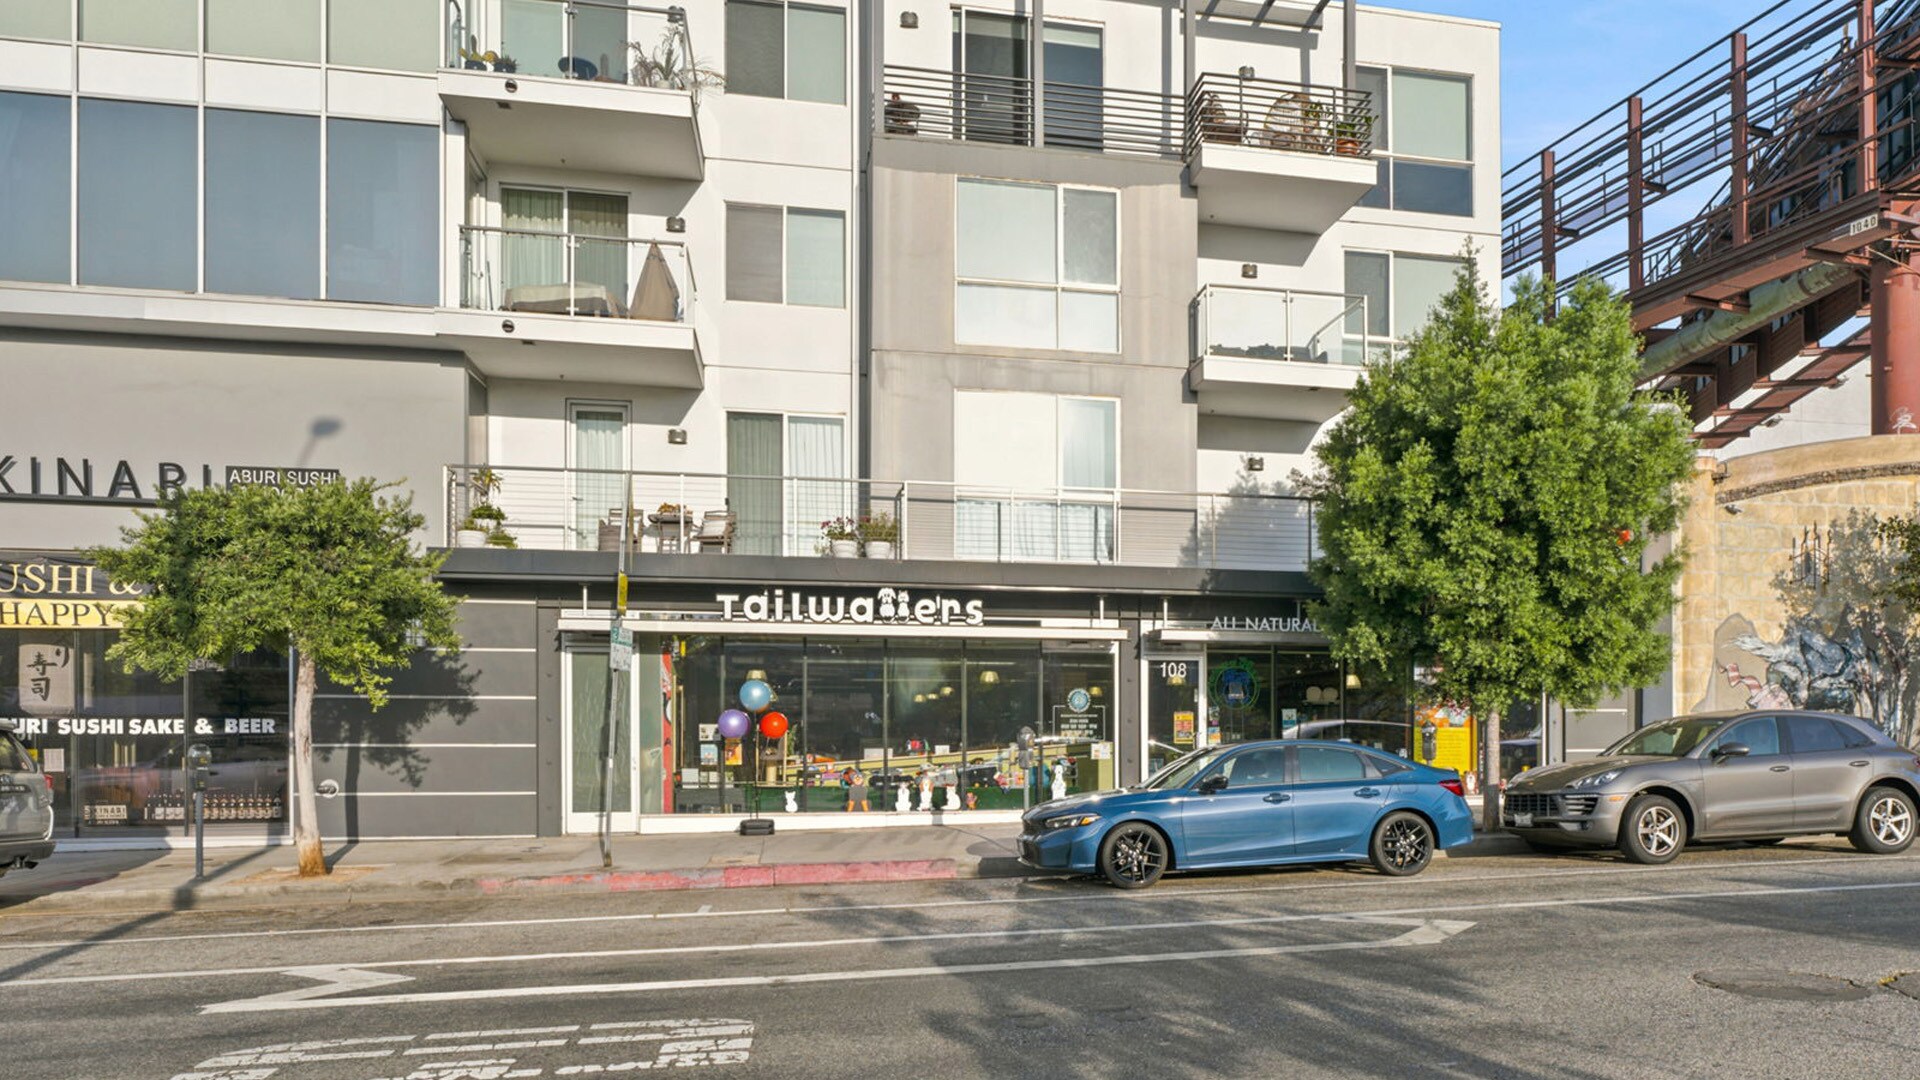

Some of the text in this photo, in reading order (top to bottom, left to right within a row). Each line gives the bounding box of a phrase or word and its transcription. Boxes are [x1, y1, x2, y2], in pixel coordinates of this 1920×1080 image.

[1852, 215, 1877, 234] 1040
[0, 455, 210, 500] KINARI
[229, 469, 337, 486] ABURI SUSHI
[0, 602, 114, 626] HAPPY
[1210, 616, 1321, 632] ALL NATURAL
[1160, 662, 1187, 678] 108
[0, 717, 276, 735] URI SUSHI SAKE & BEER
